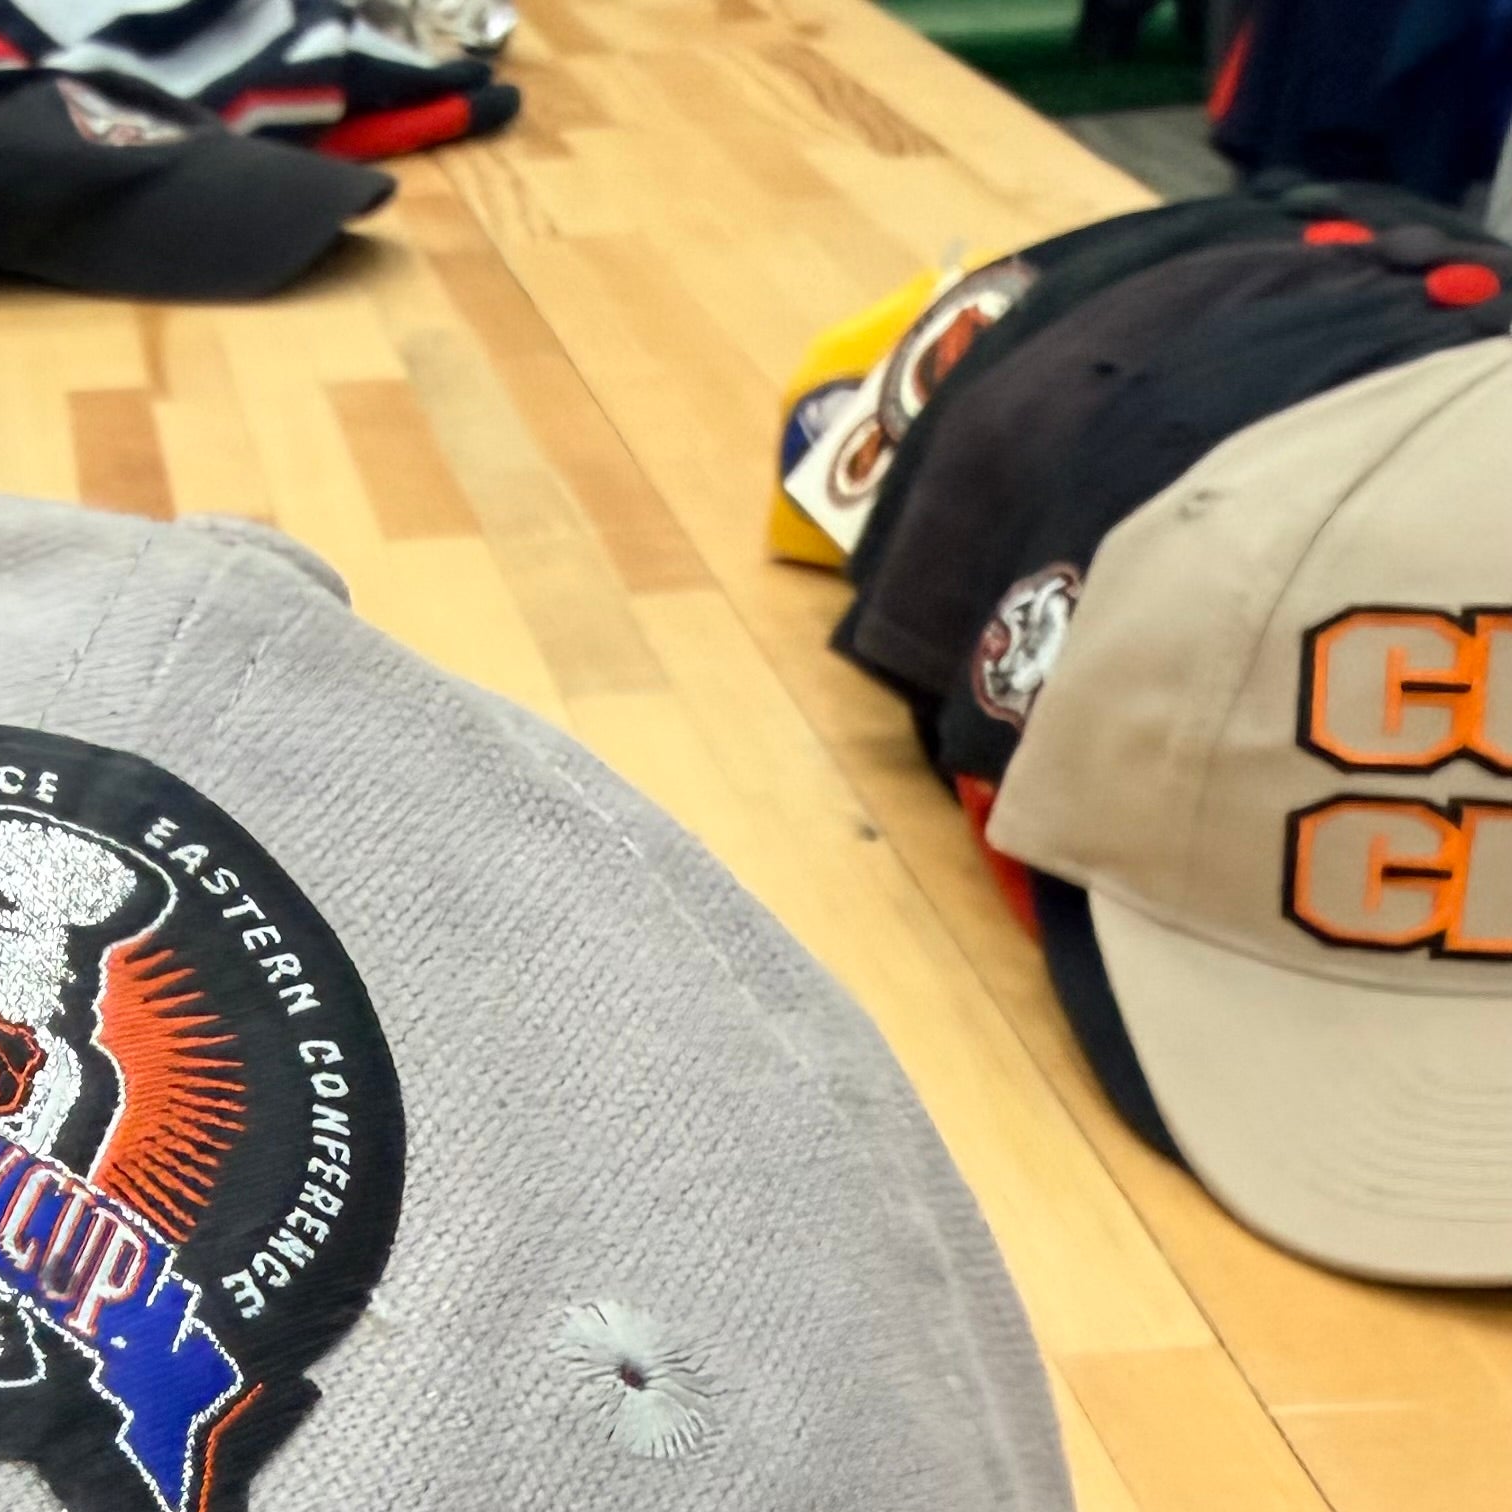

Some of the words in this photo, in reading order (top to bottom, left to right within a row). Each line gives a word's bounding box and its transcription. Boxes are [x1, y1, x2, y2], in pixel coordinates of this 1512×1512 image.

[1295, 605, 1512, 777] C
[144, 816, 322, 1017] EASTERN
[1281, 793, 1512, 960] C
[221, 1039, 351, 1319] CONFERENCE
